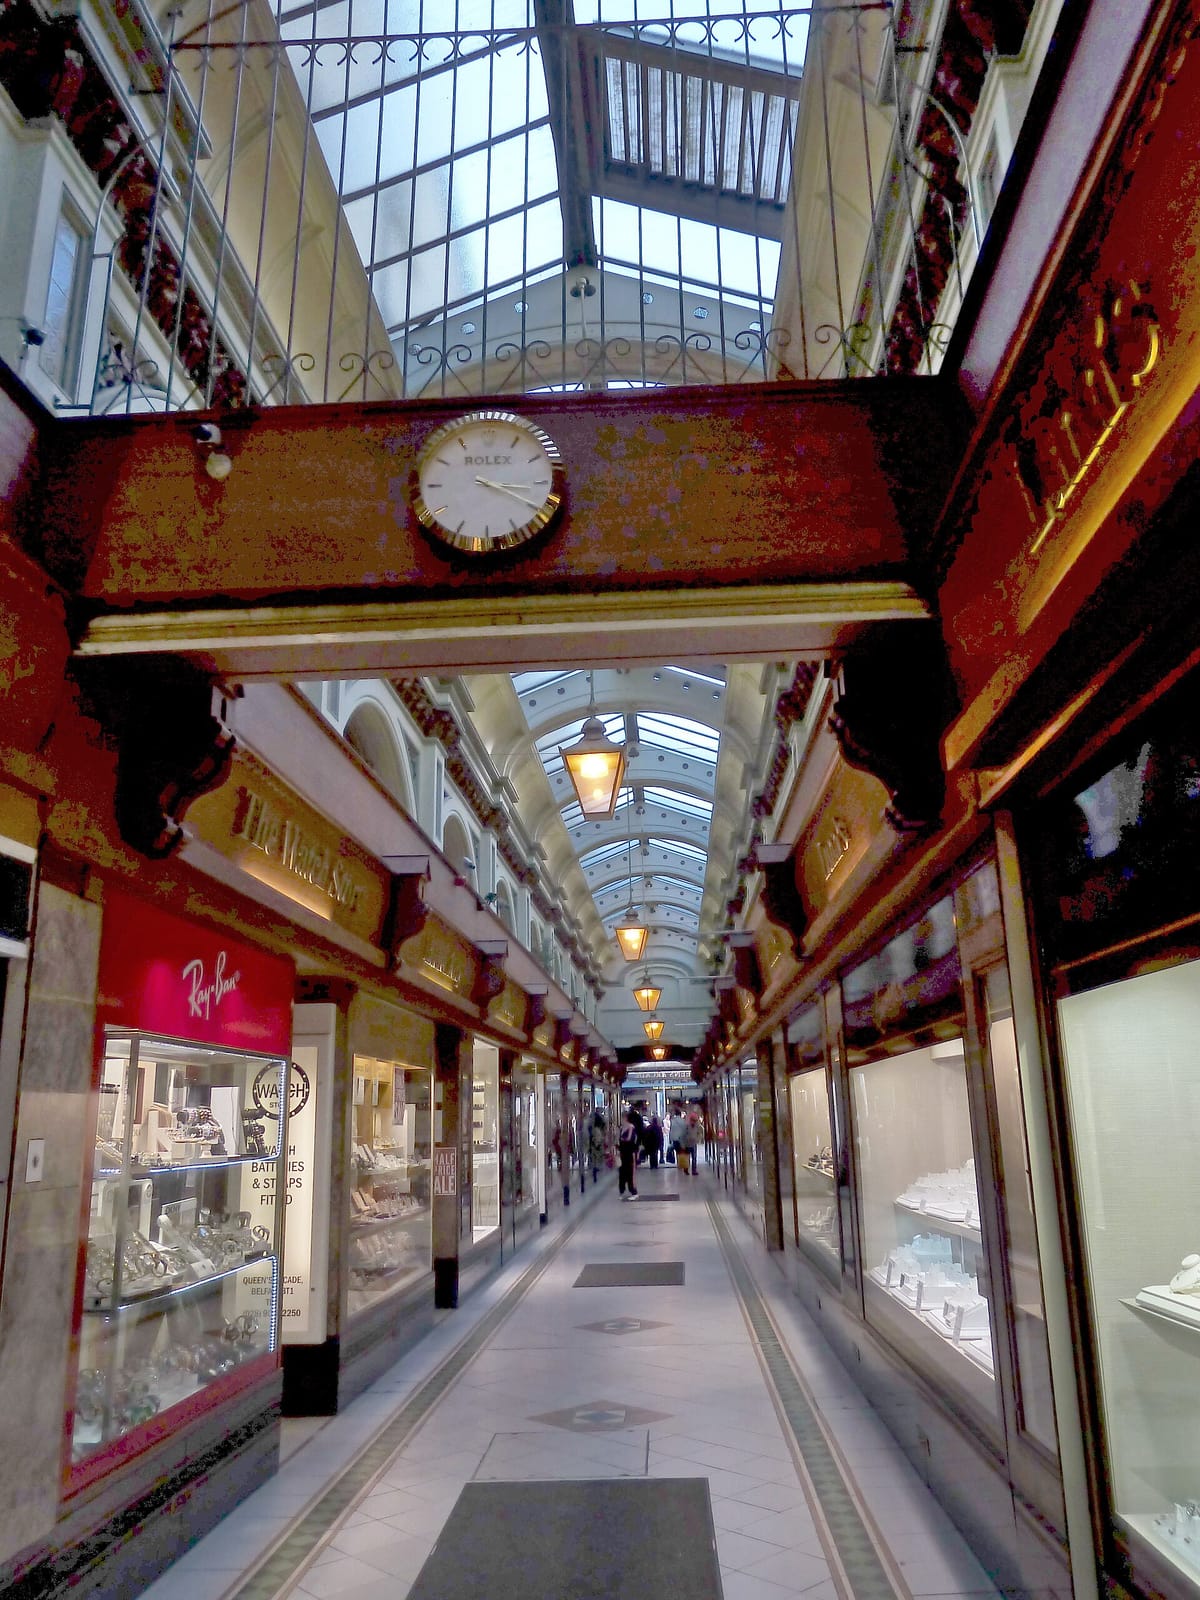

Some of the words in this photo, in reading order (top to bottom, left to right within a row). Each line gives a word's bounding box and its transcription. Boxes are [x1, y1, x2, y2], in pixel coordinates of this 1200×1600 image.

[464, 455, 512, 466] ROLEX
[257, 1083, 305, 1098] WACH
[251, 1161, 305, 1172] BATTIES
[252, 1178, 261, 1189] &
[263, 1177, 303, 1189] STPS
[434, 1175, 455, 1194] ALE
[260, 1194, 293, 1205] FITD
